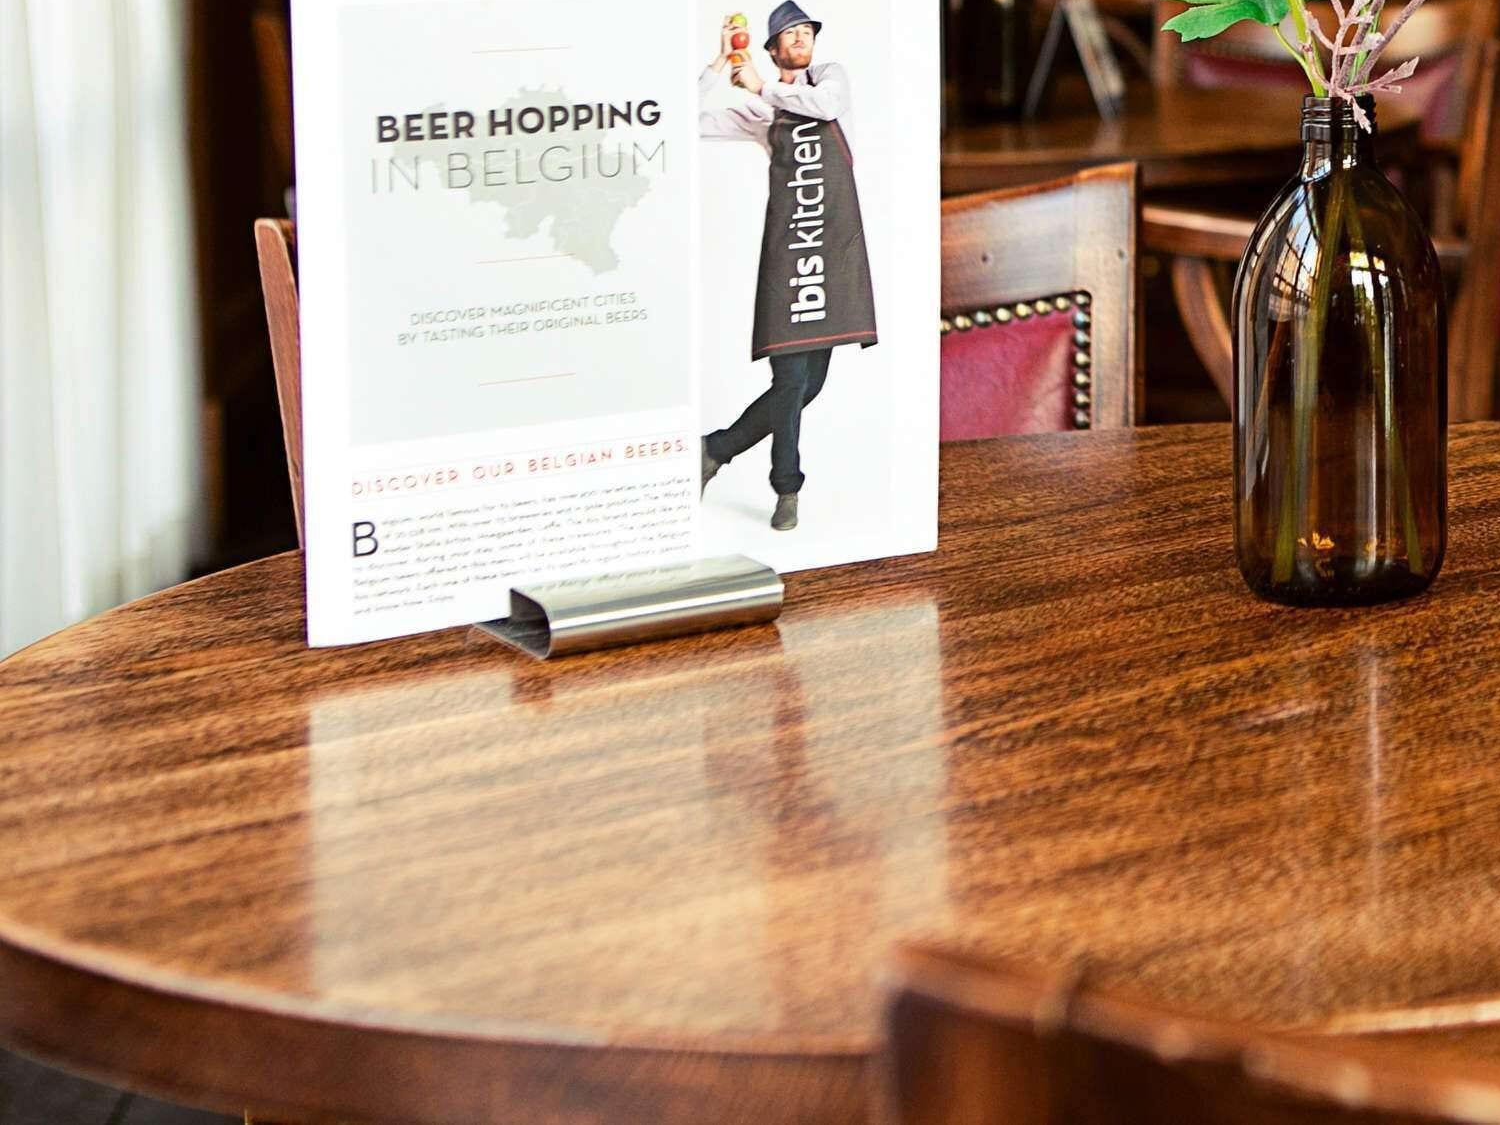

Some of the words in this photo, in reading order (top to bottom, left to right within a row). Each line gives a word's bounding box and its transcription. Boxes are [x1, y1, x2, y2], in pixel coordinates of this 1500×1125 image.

[377, 110, 475, 144] BEER
[488, 99, 661, 137] HOPPING
[371, 154, 420, 194] IN
[447, 139, 666, 190] BELGIUM
[786, 120, 825, 250] kitchen
[410, 307, 487, 326] DISCOVER
[490, 296, 590, 318] MAGNIFICENT
[593, 291, 637, 308] CITIES
[788, 254, 827, 324] ibis
[397, 333, 418, 347] BY
[423, 325, 484, 344] TASTING
[488, 320, 529, 337] THEIR
[532, 314, 602, 333] ORIGINAL
[605, 308, 649, 325] BEERS
[351, 468, 459, 497] DISCOVER
[472, 460, 515, 481] OUR
[527, 448, 613, 474] BELGIAN
